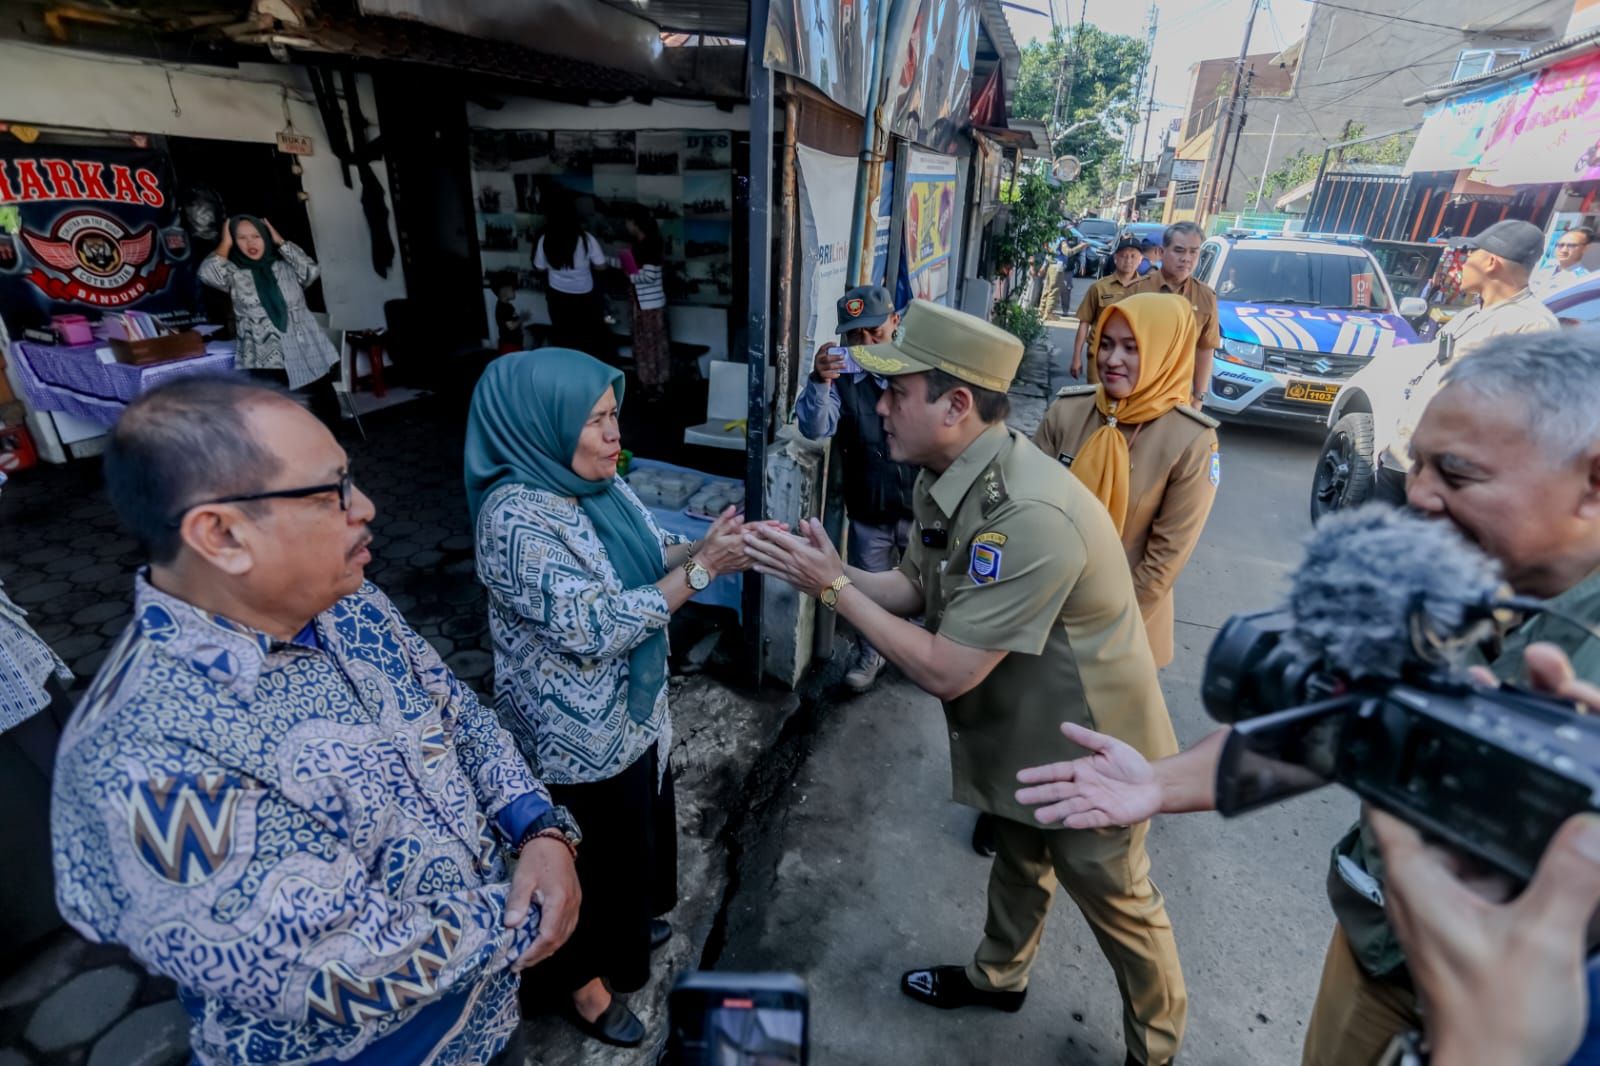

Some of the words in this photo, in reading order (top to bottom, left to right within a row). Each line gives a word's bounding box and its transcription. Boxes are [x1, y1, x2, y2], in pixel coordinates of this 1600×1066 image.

[77, 282, 145, 305] BANDUNG
[1236, 306, 1393, 329] POLISI
[1217, 370, 1264, 384] police
